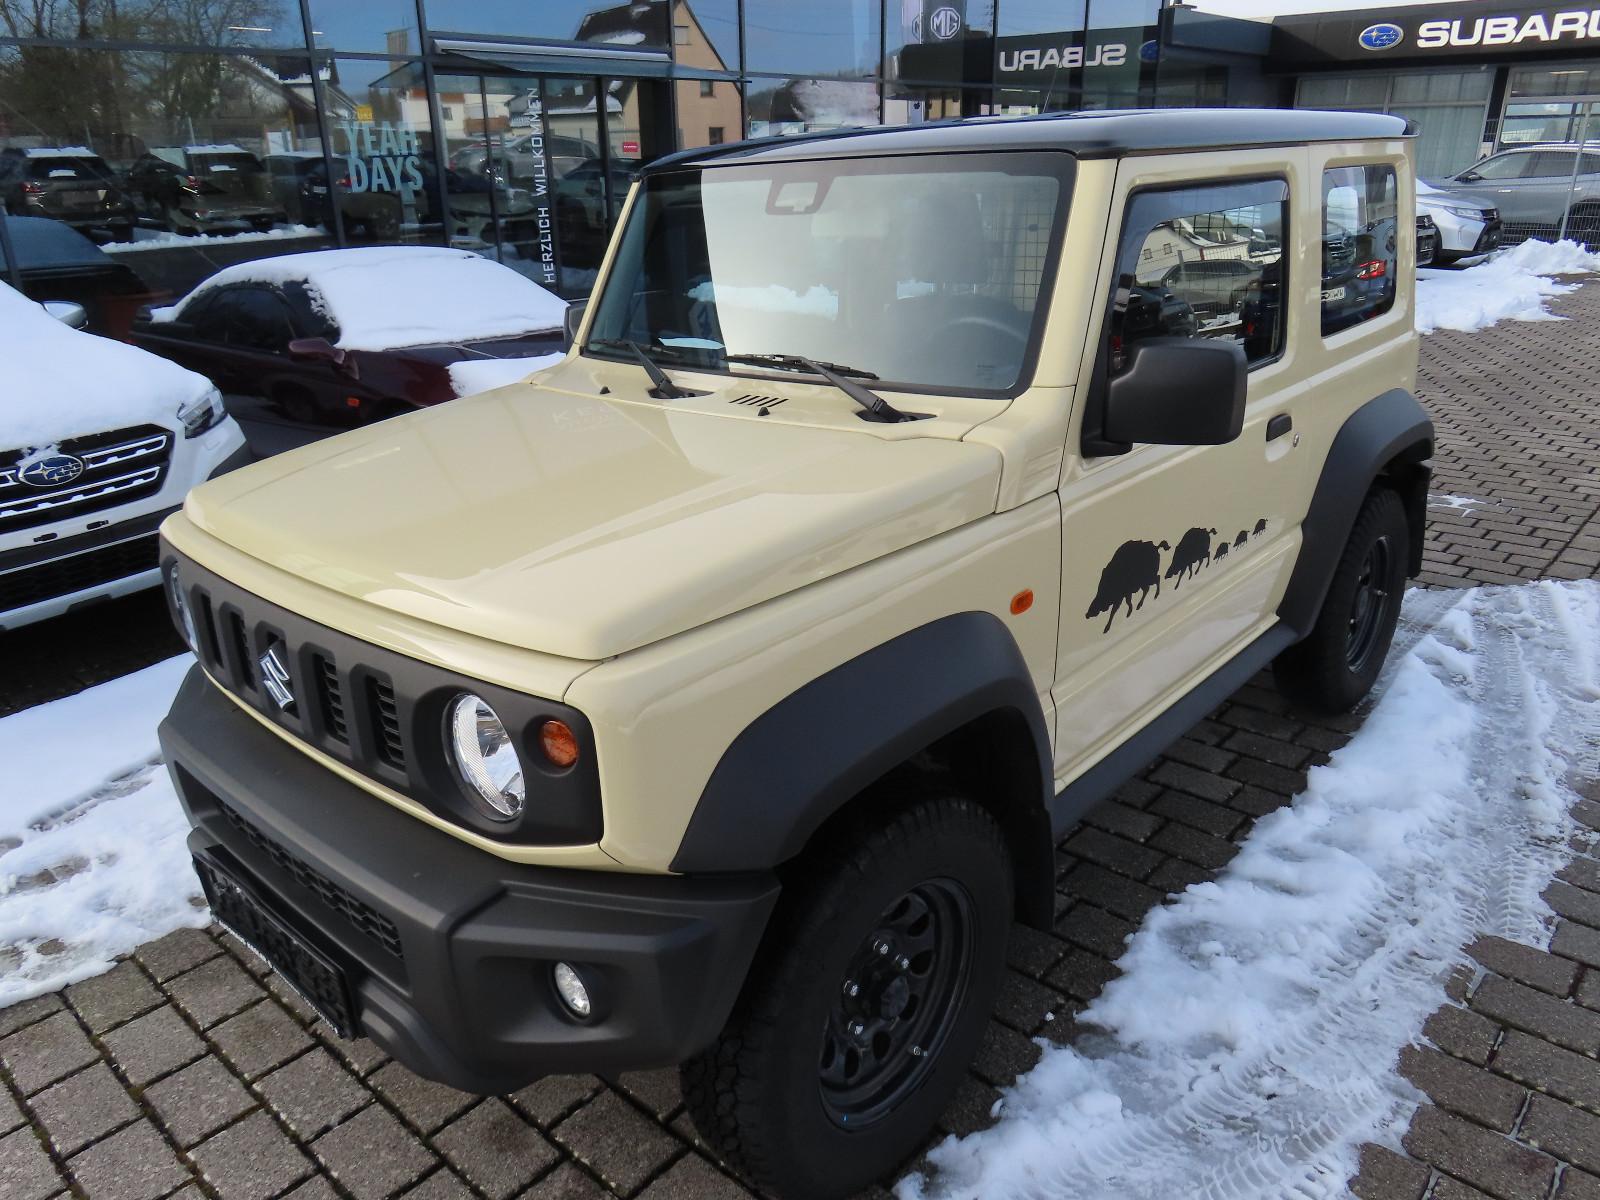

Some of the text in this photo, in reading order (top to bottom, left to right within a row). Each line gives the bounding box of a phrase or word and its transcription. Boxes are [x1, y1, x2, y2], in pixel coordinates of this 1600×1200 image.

[933, 10, 959, 38] MG
[341, 121, 419, 156] YEAH
[347, 155, 424, 193] DAYS
[527, 87, 556, 283] HERZLICH WILLKOMMEN
